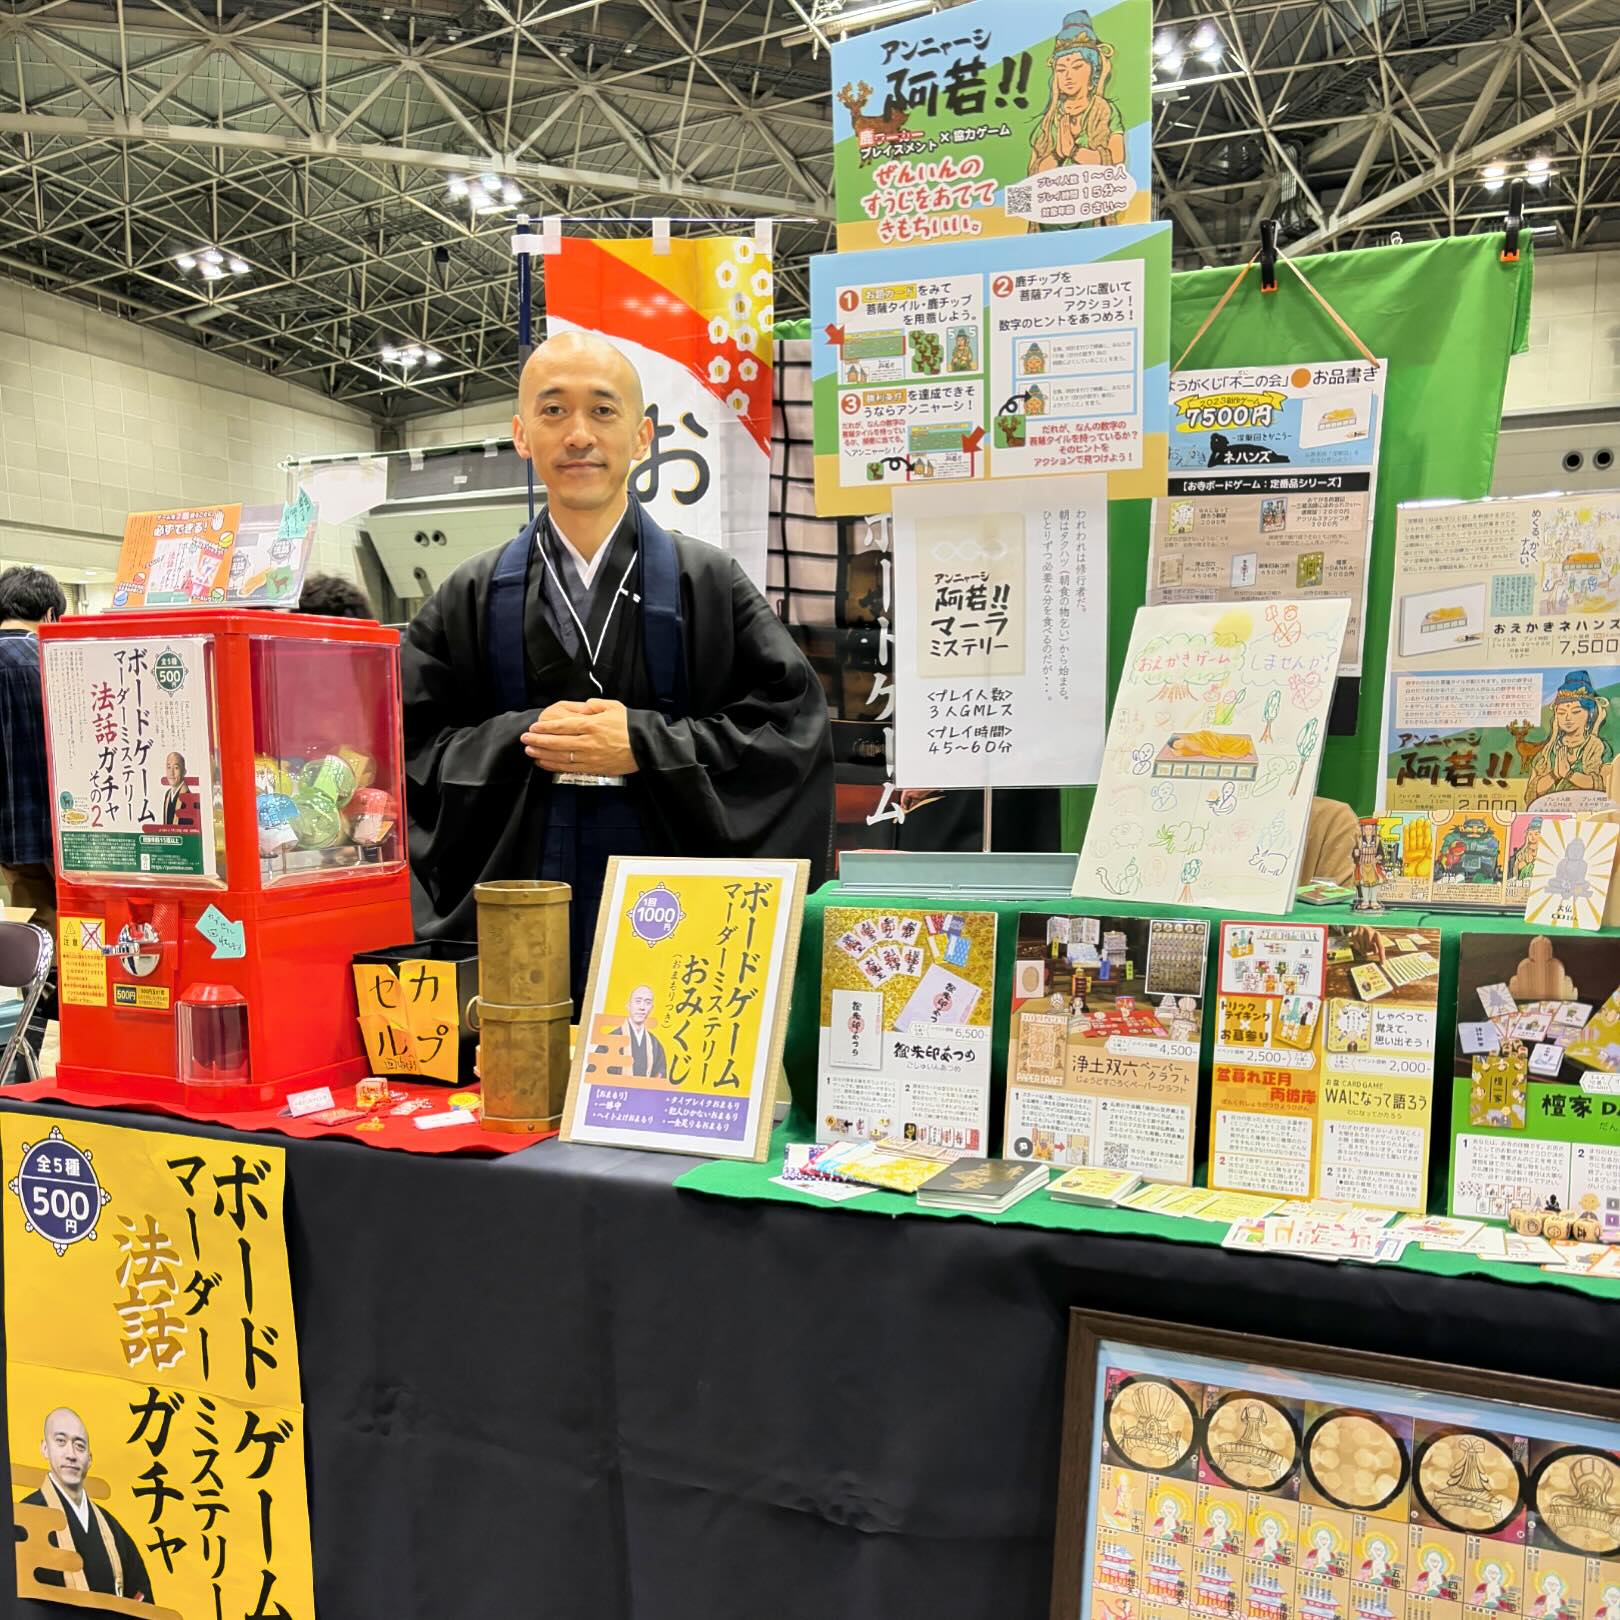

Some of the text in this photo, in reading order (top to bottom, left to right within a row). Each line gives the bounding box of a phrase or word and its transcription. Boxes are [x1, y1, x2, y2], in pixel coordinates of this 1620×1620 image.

[953, 124, 1013, 143] 協力ゲーム
[861, 141, 938, 160] プレイスメント
[876, 156, 983, 188] ぜんいんの
[862, 181, 997, 219] すうじをあてて
[1015, 271, 1072, 289] 鹿チップを
[1019, 281, 1132, 303] 菩薩アイコンに置いて
[903, 309, 978, 326] を用意しよう。
[1312, 366, 1379, 386] お品書き
[1185, 404, 1273, 429] 7500円
[1042, 421, 1127, 435] だれが、なんの数字の
[628, 403, 710, 506] お
[1058, 443, 1110, 455] そのヒントを
[1223, 450, 1272, 464] ネハンズ
[1075, 509, 1088, 613] われわれは修行者だ。
[934, 572, 990, 585] アンニャーシ
[931, 612, 1009, 636] マーラ
[930, 638, 1009, 657] ミステリー
[159, 669, 181, 684] 500
[113, 650, 135, 823] マーダーミステリー
[127, 647, 156, 824] ボードゲーム
[1398, 733, 1482, 748] アンニャーシ
[90, 681, 120, 823] 法話ガチャ
[643, 898, 657, 907] 1回
[637, 906, 676, 923] 1000
[116, 988, 136, 1001] 500円
[701, 882, 743, 1086] マーダーミステリー
[714, 881, 773, 1089] ボードゲーム
[1220, 1001, 1256, 1012] トリック
[669, 954, 709, 1085] おみくじ
[1376, 1012, 1429, 1024] しゃべって、
[1375, 1024, 1409, 1035] 覚えて、
[1072, 1055, 1139, 1078] 浄土双六
[1147, 1072, 1191, 1084] クラフト
[1325, 1089, 1427, 1112] WAになって語ろう
[1541, 1093, 1593, 1119] 檀家
[36, 1153, 81, 1177] 全5種
[32, 1186, 91, 1223] 500
[65, 1218, 78, 1235] 円
[111, 1213, 189, 1575] 法話ガチャ
[212, 1155, 294, 1620] ボードゲーム
